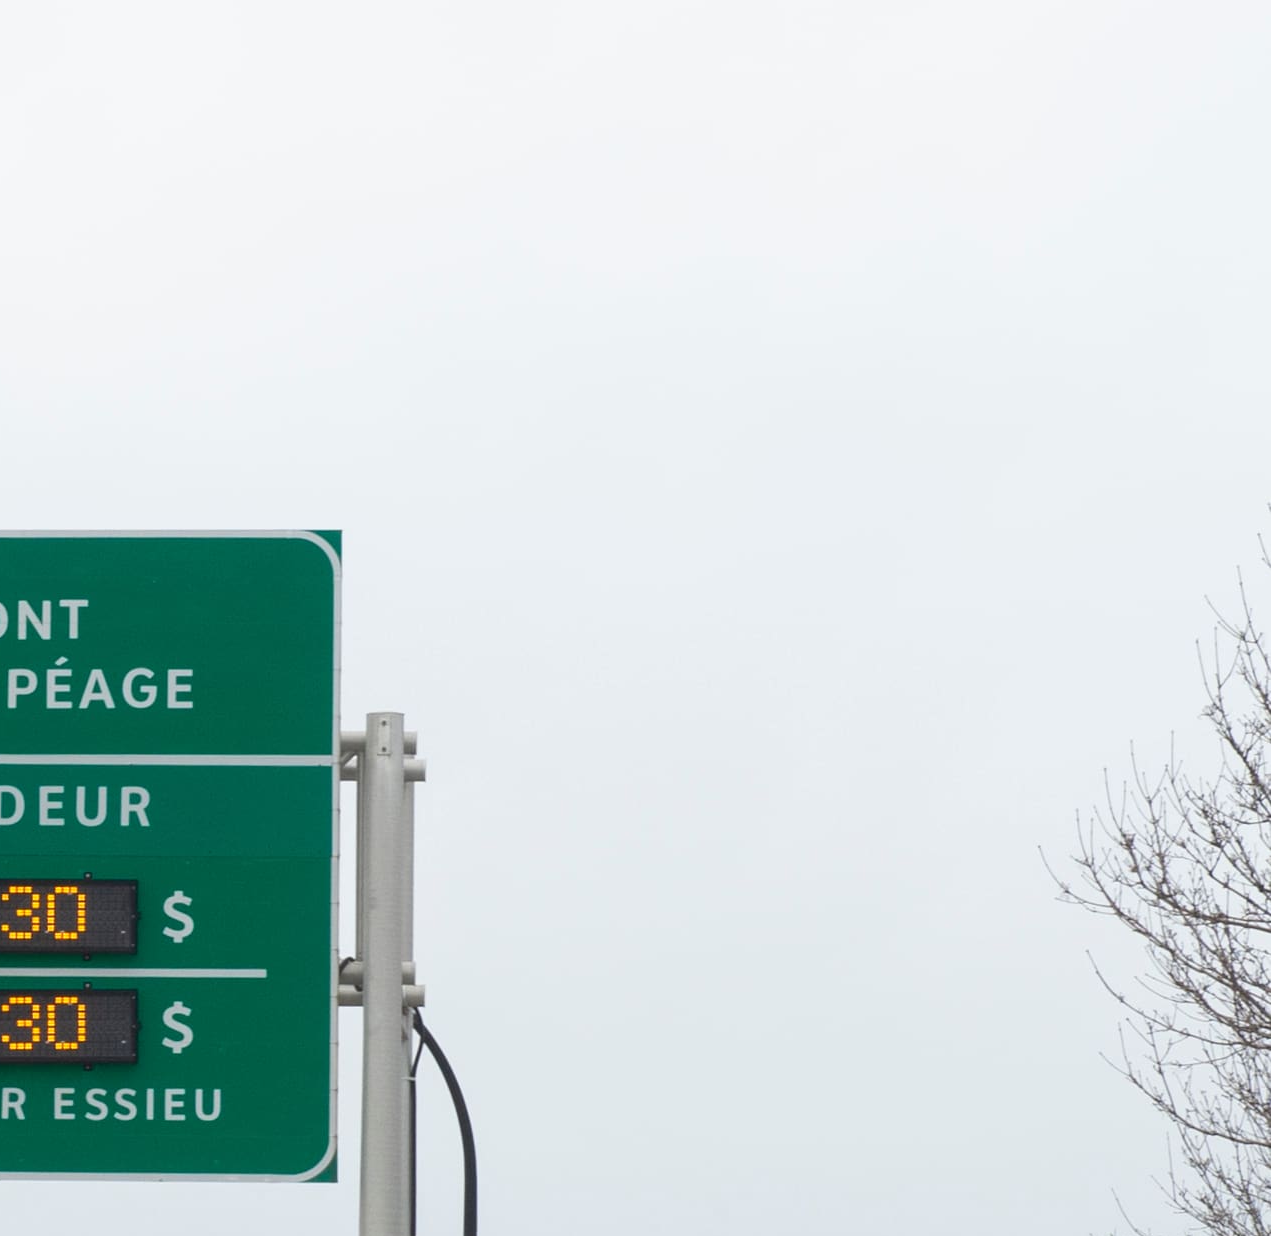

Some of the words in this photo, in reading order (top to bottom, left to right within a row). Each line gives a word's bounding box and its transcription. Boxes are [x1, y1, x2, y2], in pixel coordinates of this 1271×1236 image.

[8, 659, 193, 708] PÉAGE
[163, 891, 193, 942] $
[162, 1002, 193, 1053] $
[55, 1088, 221, 1120] ESSIEU
